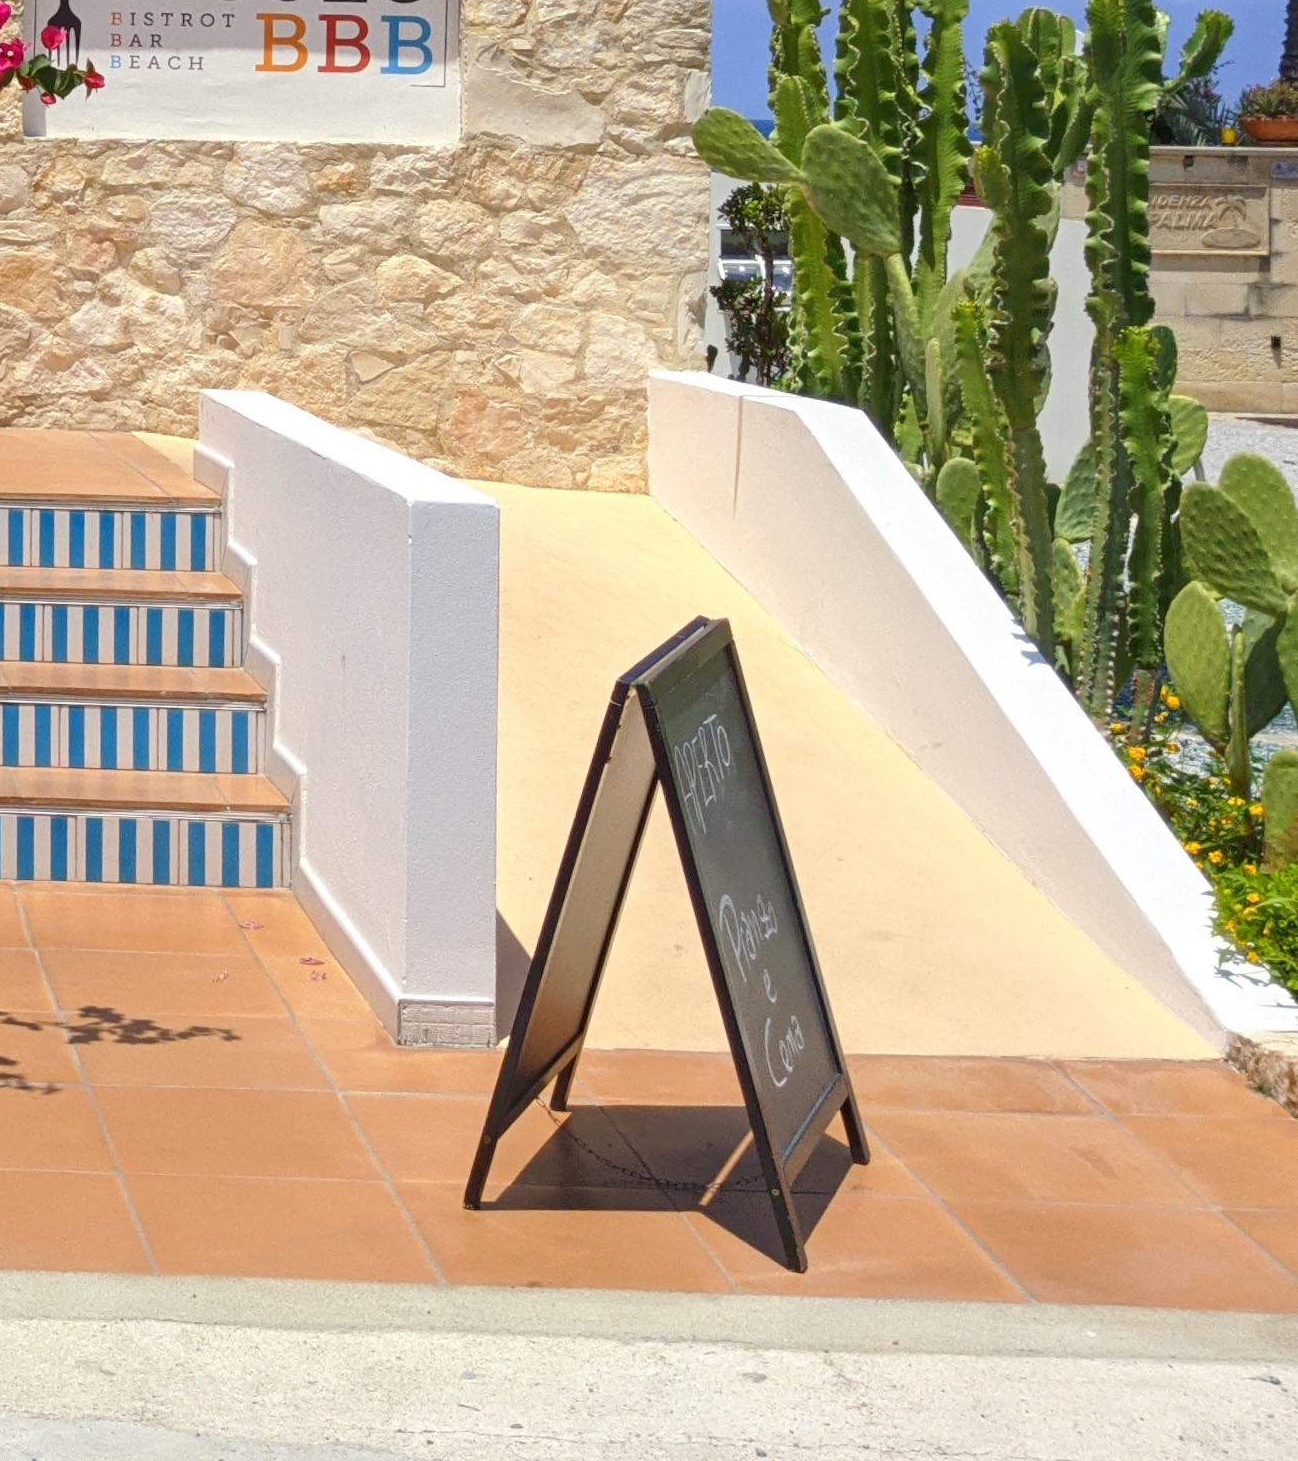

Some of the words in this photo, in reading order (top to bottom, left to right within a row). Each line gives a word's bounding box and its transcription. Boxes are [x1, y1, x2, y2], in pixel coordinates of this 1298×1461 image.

[110, 11, 235, 28] BISTROT
[110, 33, 163, 48] BAR
[254, 12, 433, 75] BBB
[109, 54, 204, 71] BEACH
[673, 713, 731, 837] APERTO
[762, 968, 778, 1004] e
